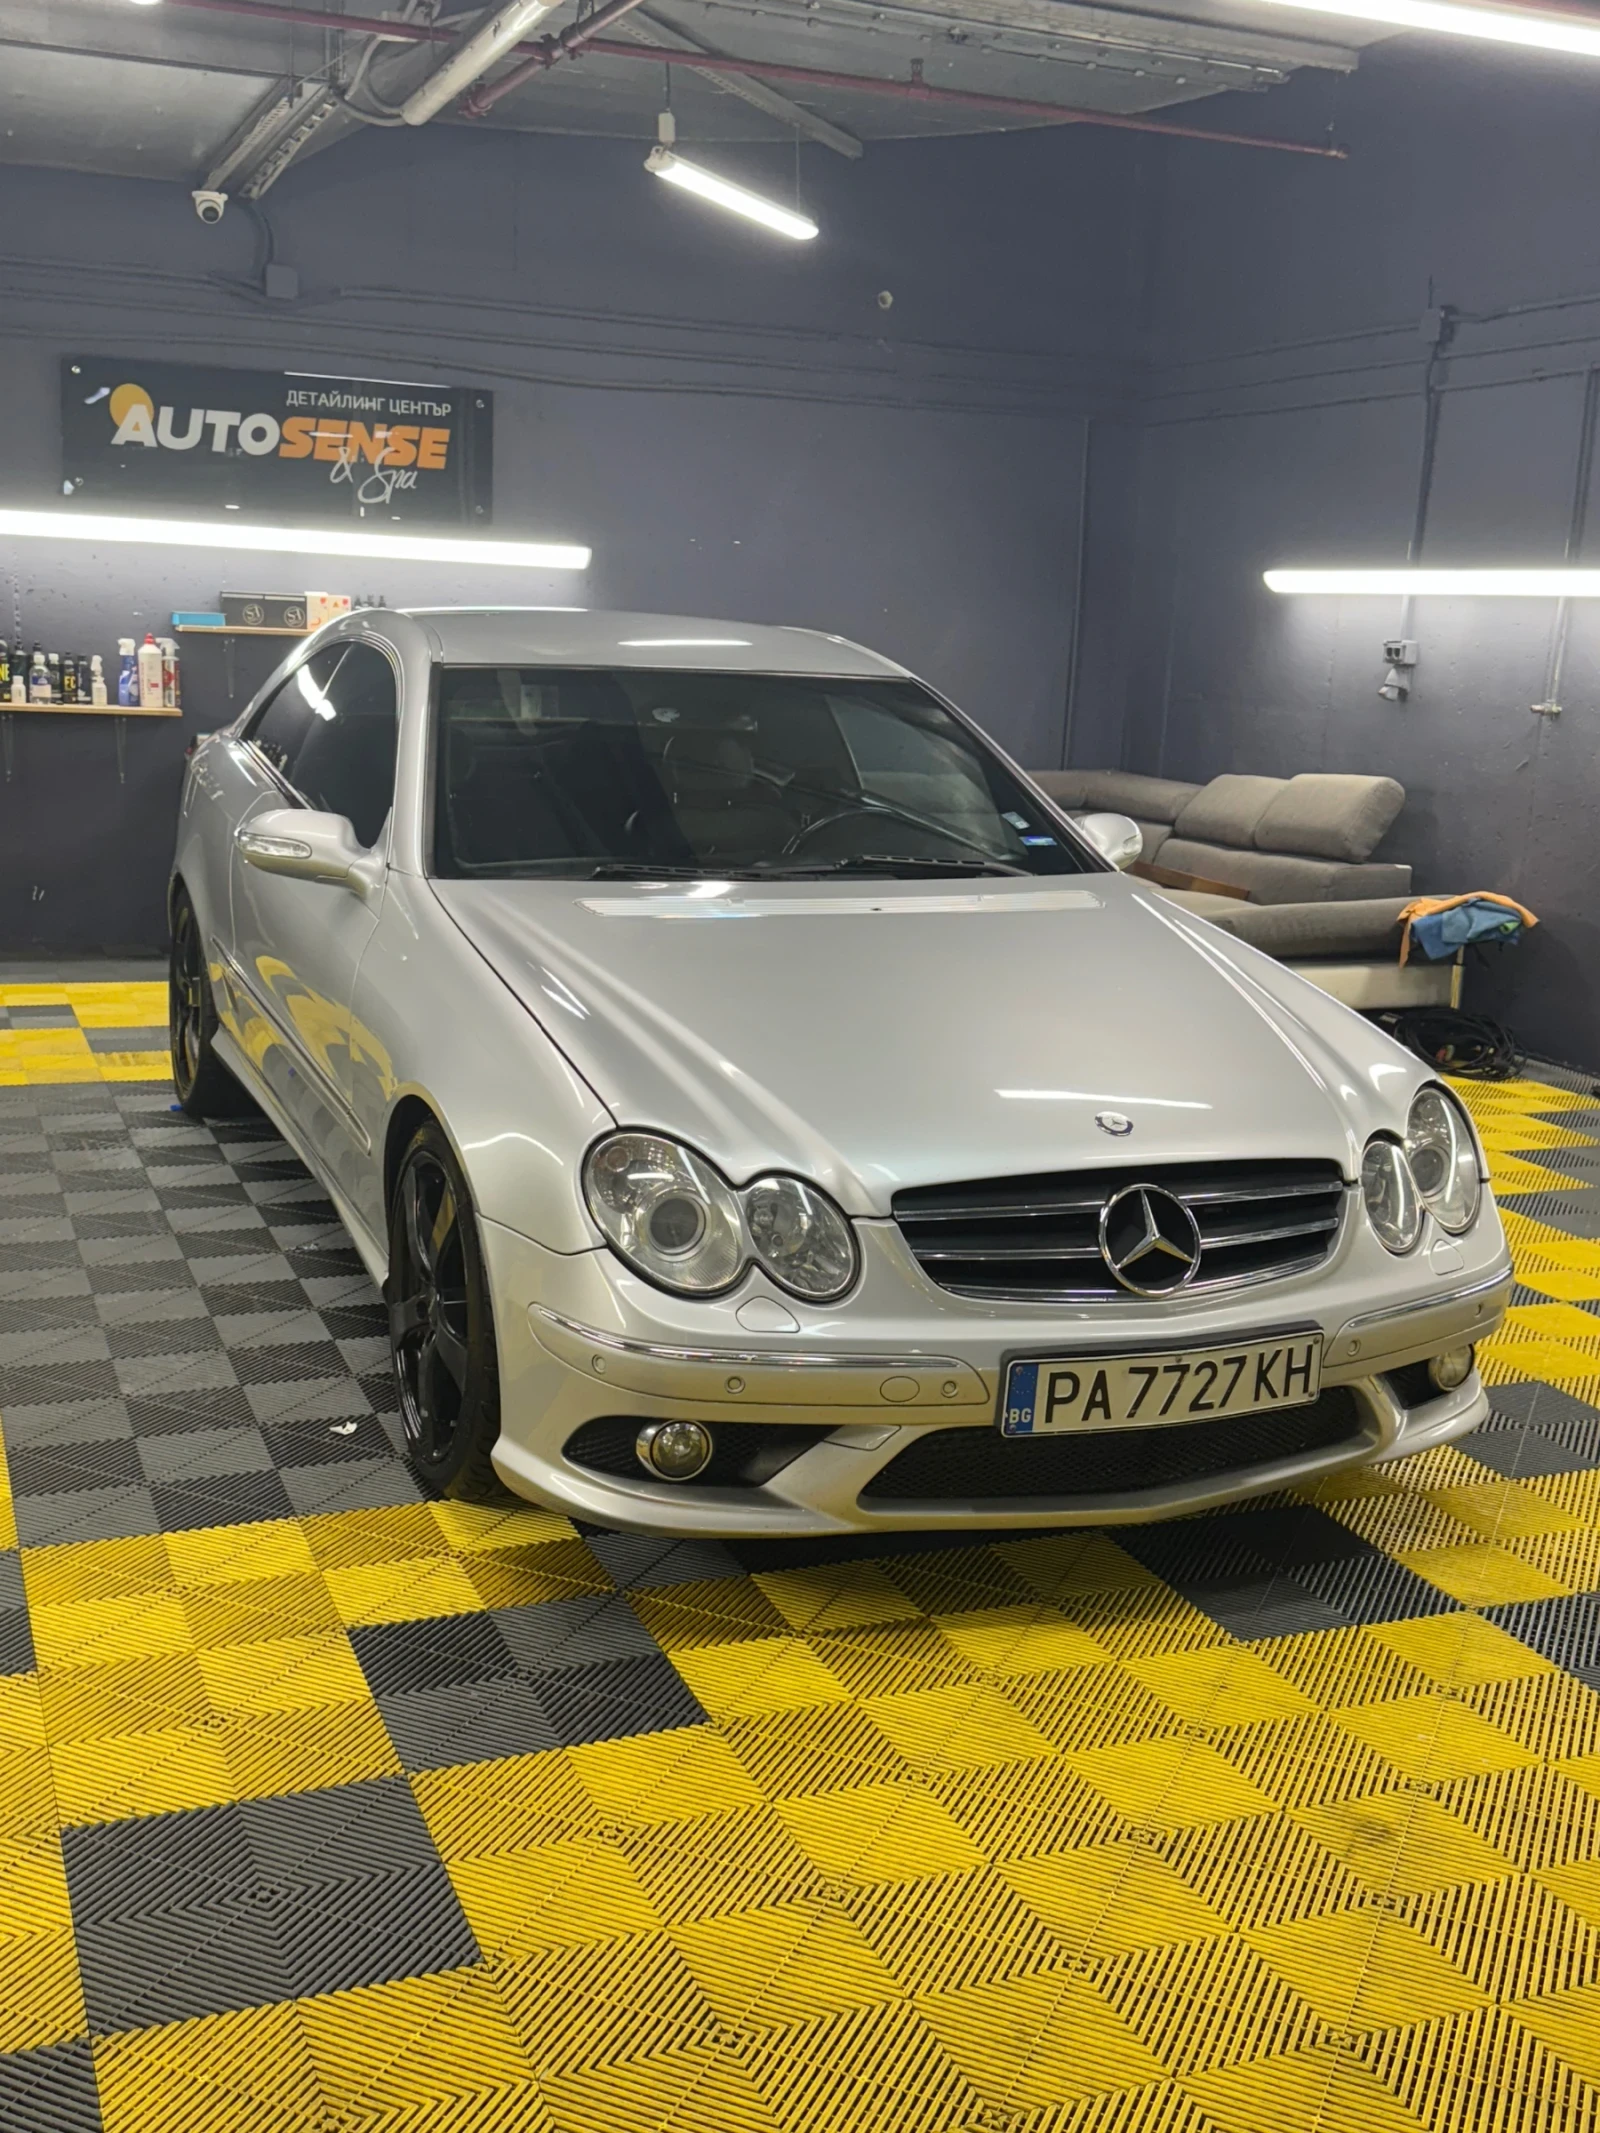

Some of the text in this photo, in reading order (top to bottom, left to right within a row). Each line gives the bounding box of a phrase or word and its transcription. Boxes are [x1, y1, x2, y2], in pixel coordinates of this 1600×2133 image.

[286, 389, 452, 418] ДЕТАЙЛИНГ ЦЕНТЪР
[330, 445, 417, 504] & Spa
[1008, 1408, 1032, 1424] BG
